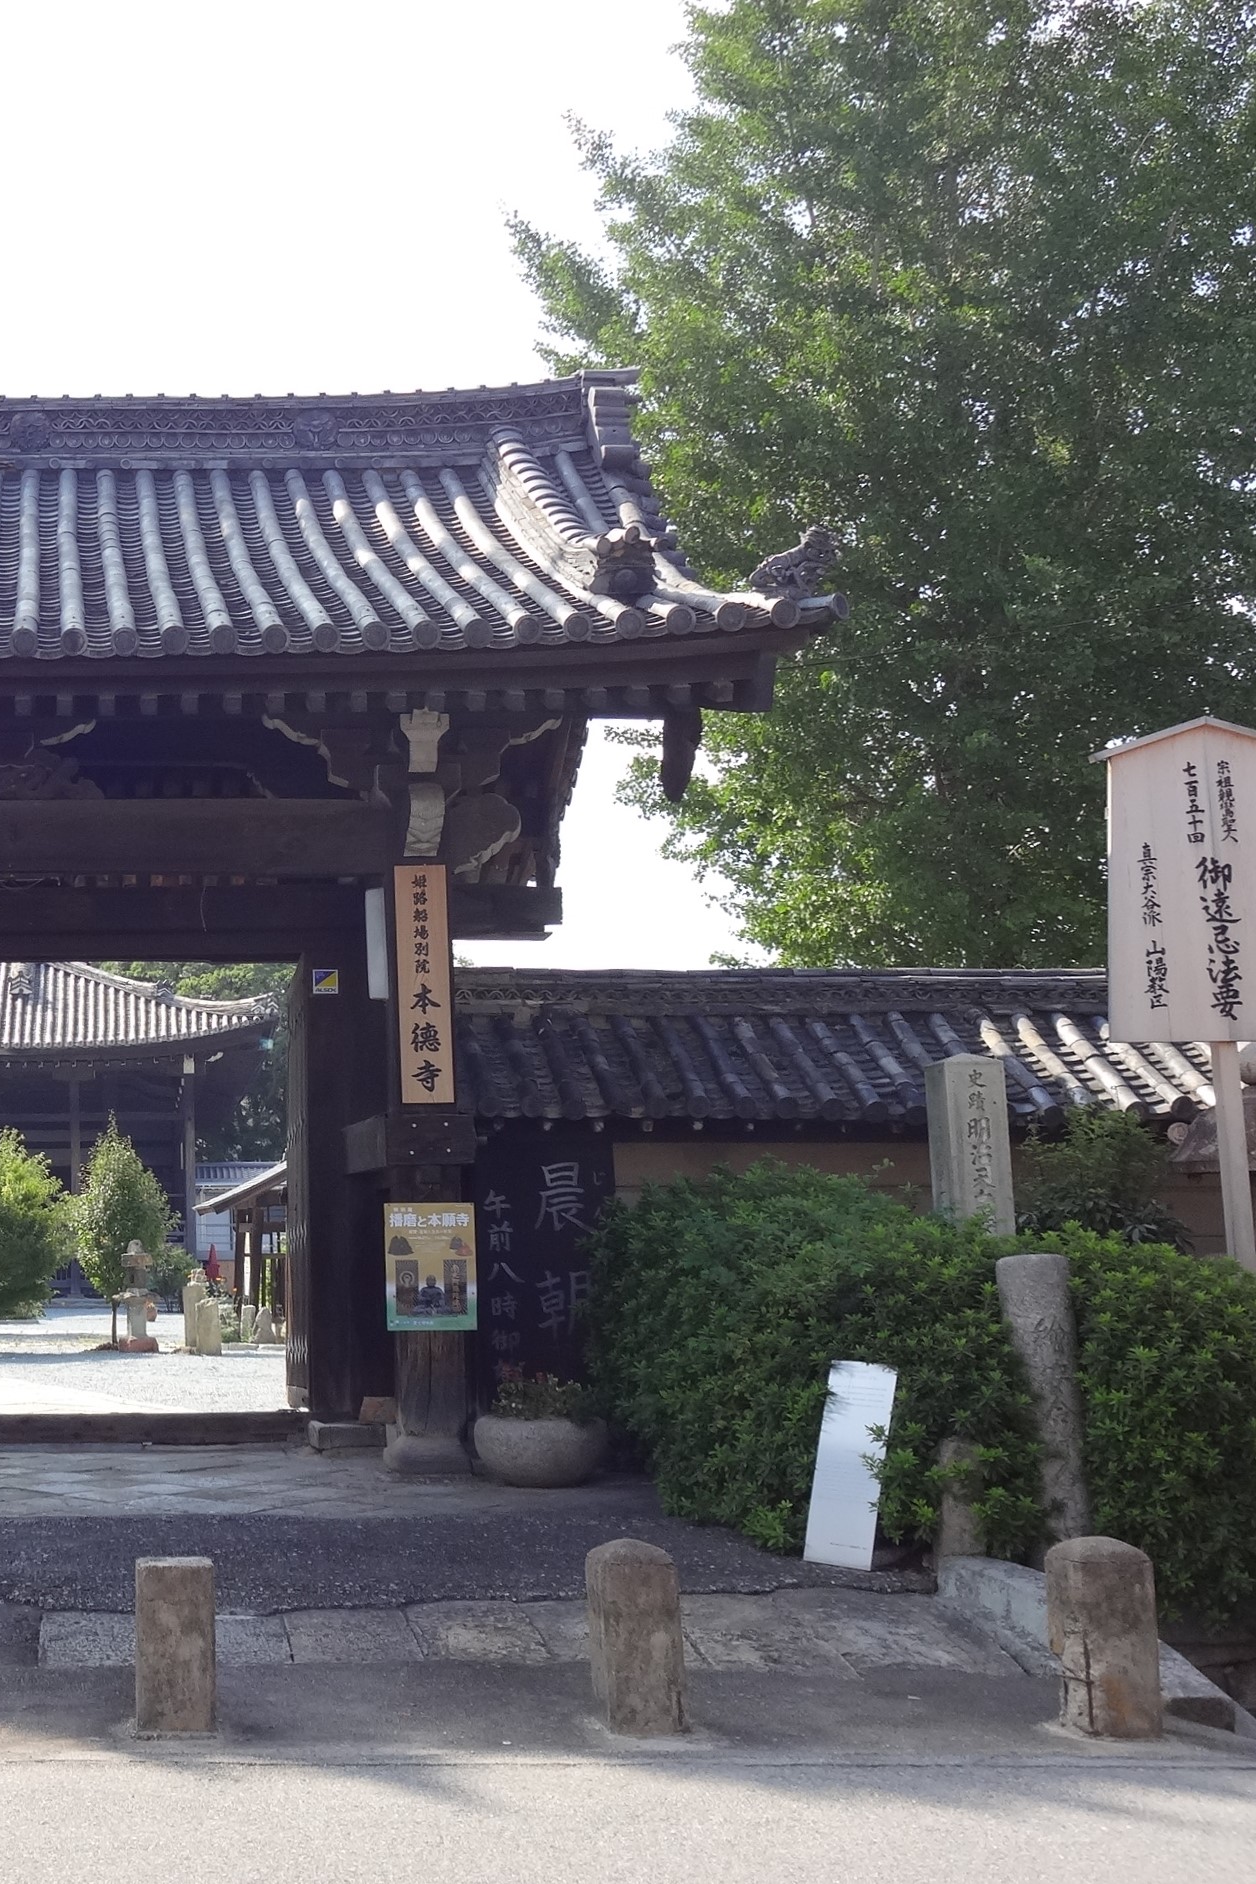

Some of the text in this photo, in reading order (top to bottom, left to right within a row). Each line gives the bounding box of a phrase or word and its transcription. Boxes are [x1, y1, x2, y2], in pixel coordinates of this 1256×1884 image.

[1182, 761, 1205, 843] 七百五十回
[1137, 842, 1169, 1009] 真宗大谷派 山陽教区
[1195, 856, 1243, 1021] 御遠忌法要
[389, 1213, 469, 1227] 播磨と本願寺
